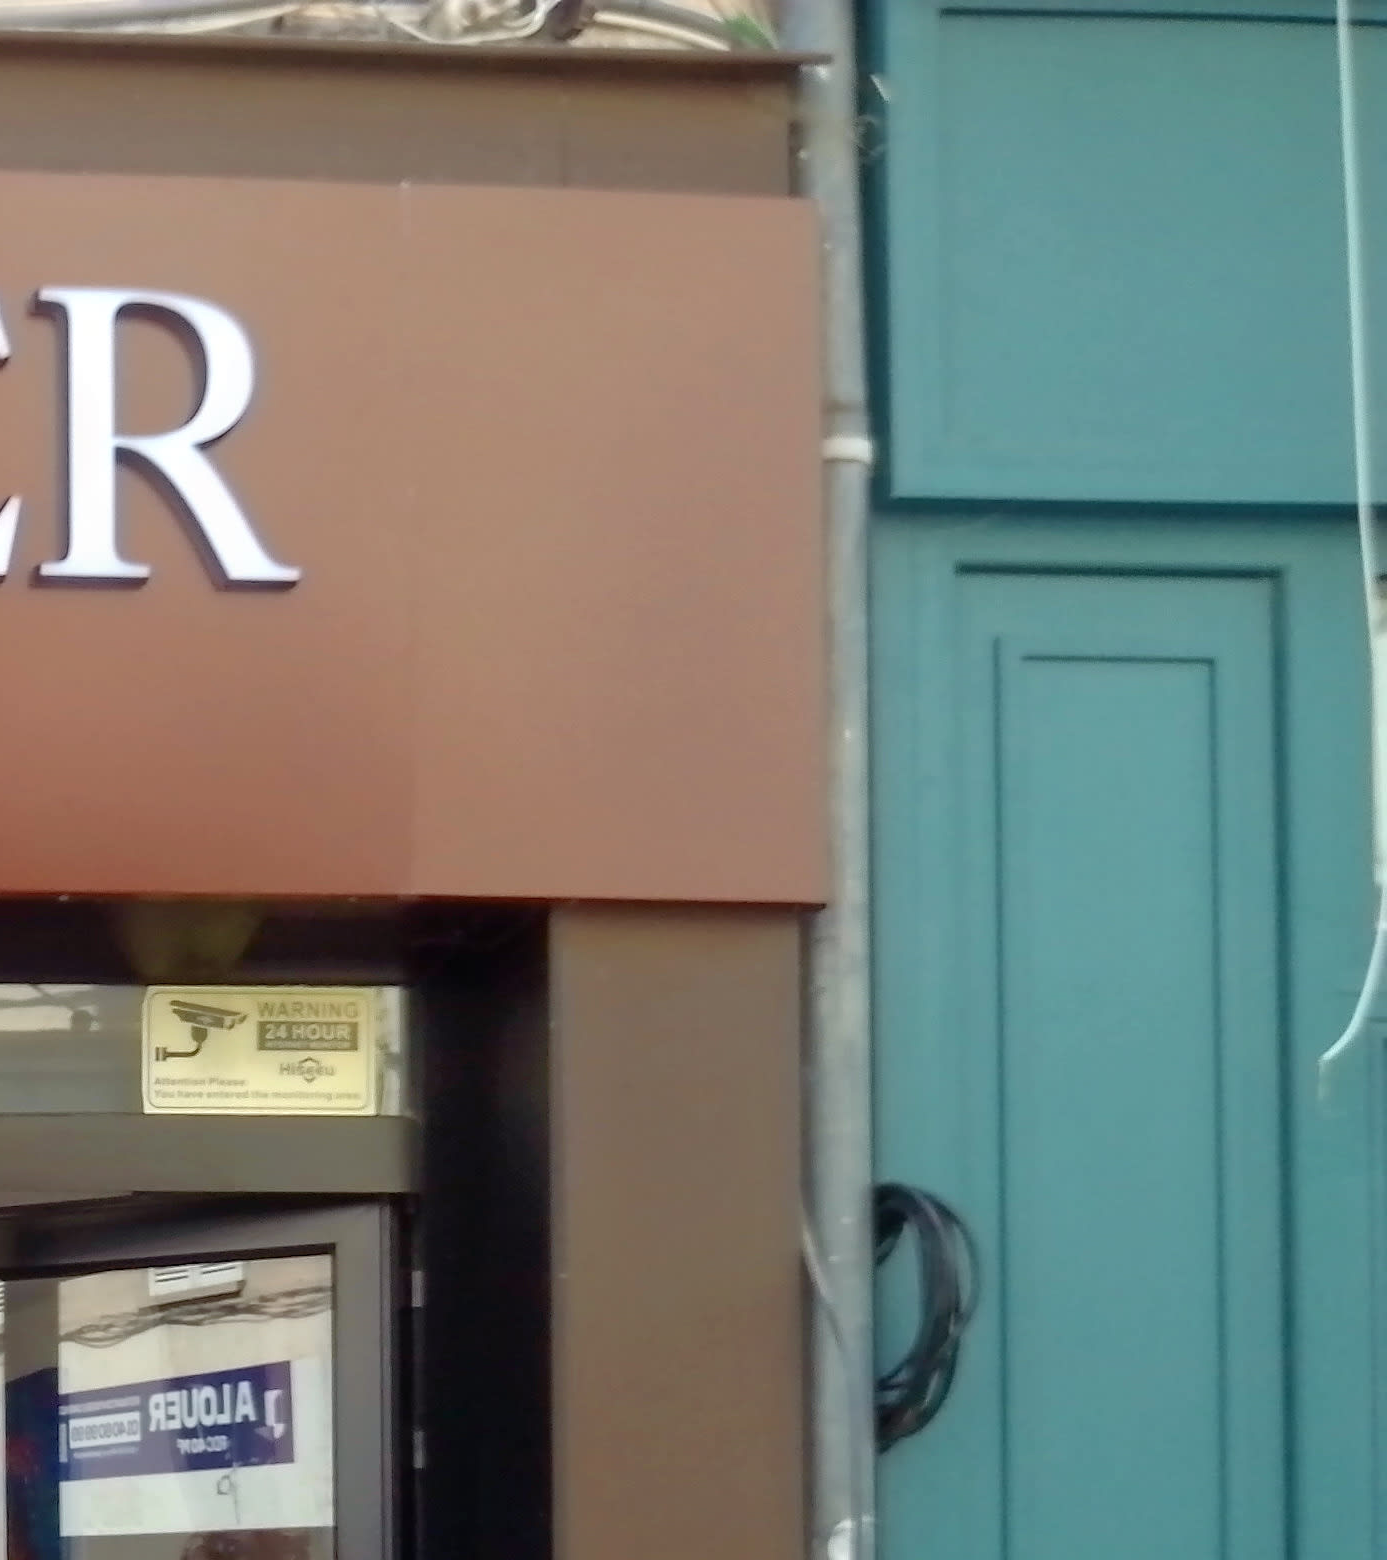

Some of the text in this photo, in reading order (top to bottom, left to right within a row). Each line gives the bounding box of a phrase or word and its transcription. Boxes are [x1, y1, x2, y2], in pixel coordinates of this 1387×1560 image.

[256, 1001, 359, 1018] WARNING
[265, 1024, 351, 1041] 24 HOUR
